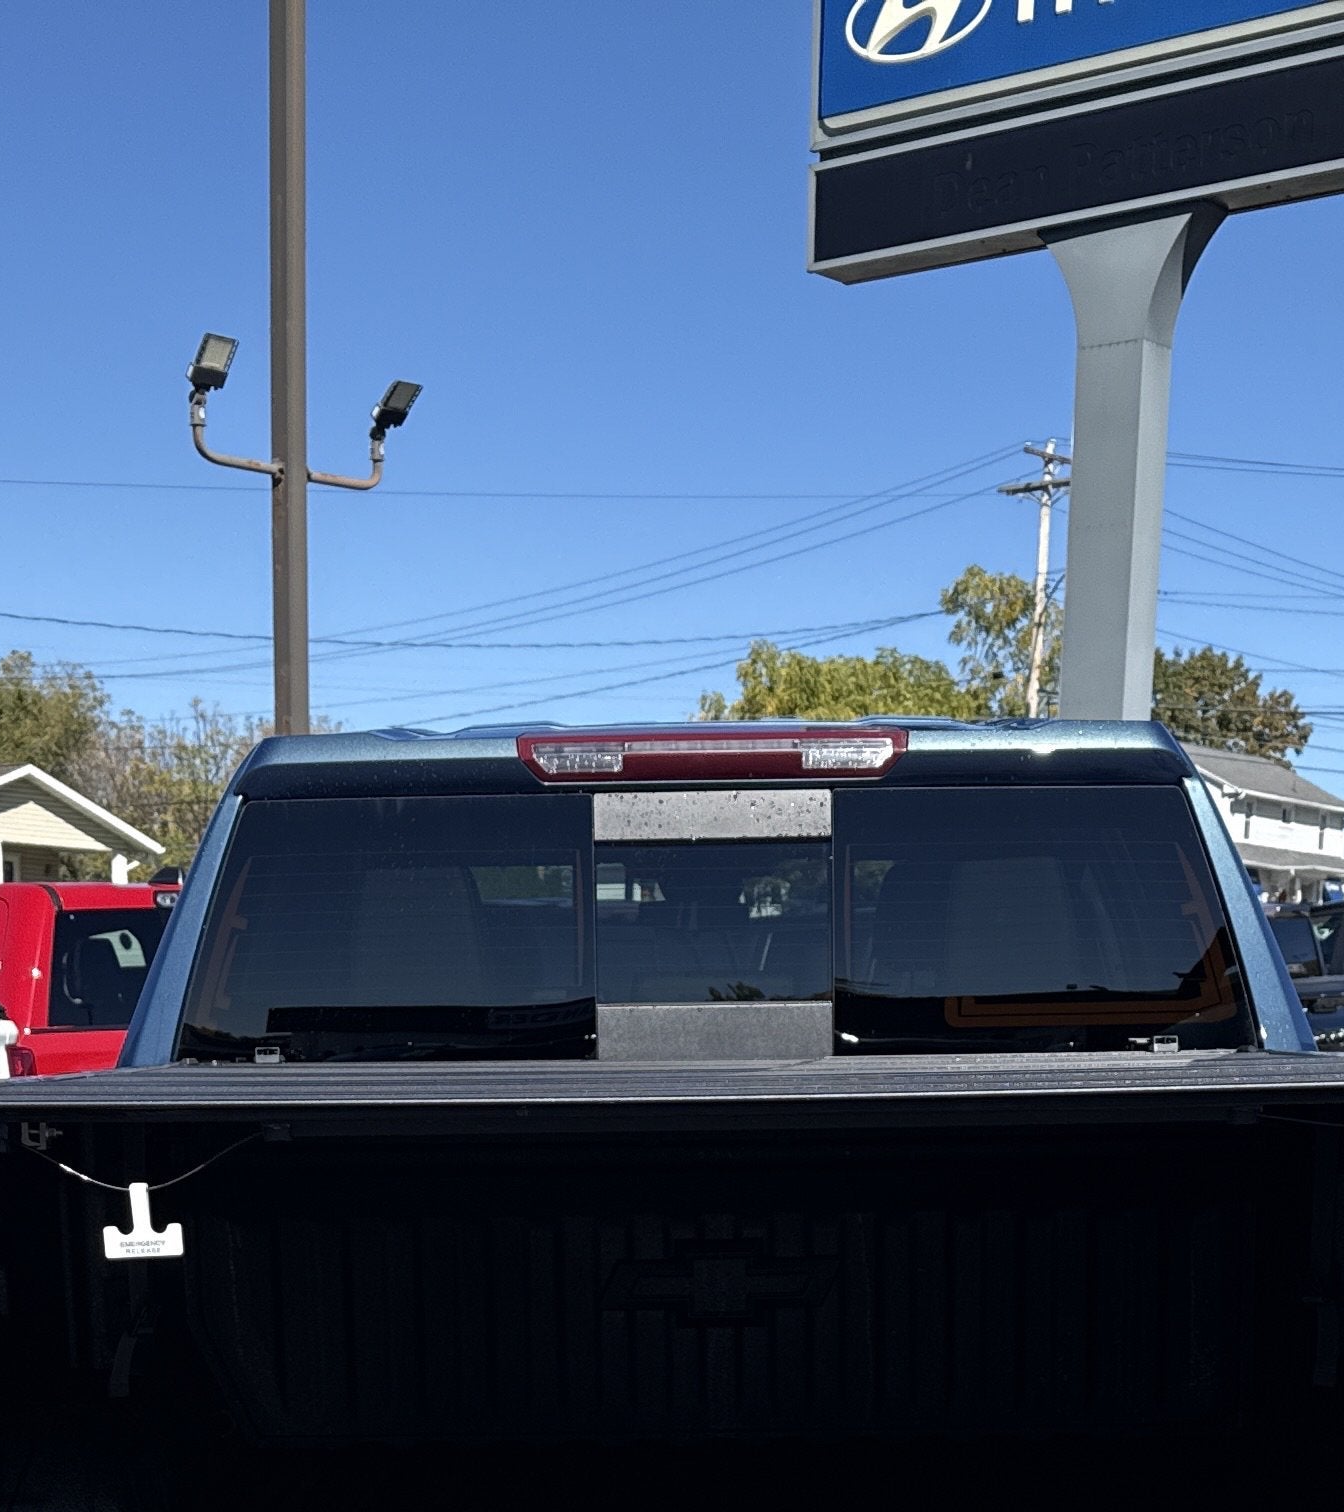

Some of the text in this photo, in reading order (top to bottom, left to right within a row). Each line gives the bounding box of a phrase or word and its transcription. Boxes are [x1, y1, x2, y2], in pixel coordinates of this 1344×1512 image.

[1074, 108, 1315, 184] Patterson
[120, 1240, 166, 1248] EMERGENCY
[126, 1247, 161, 1255] RELEASE
